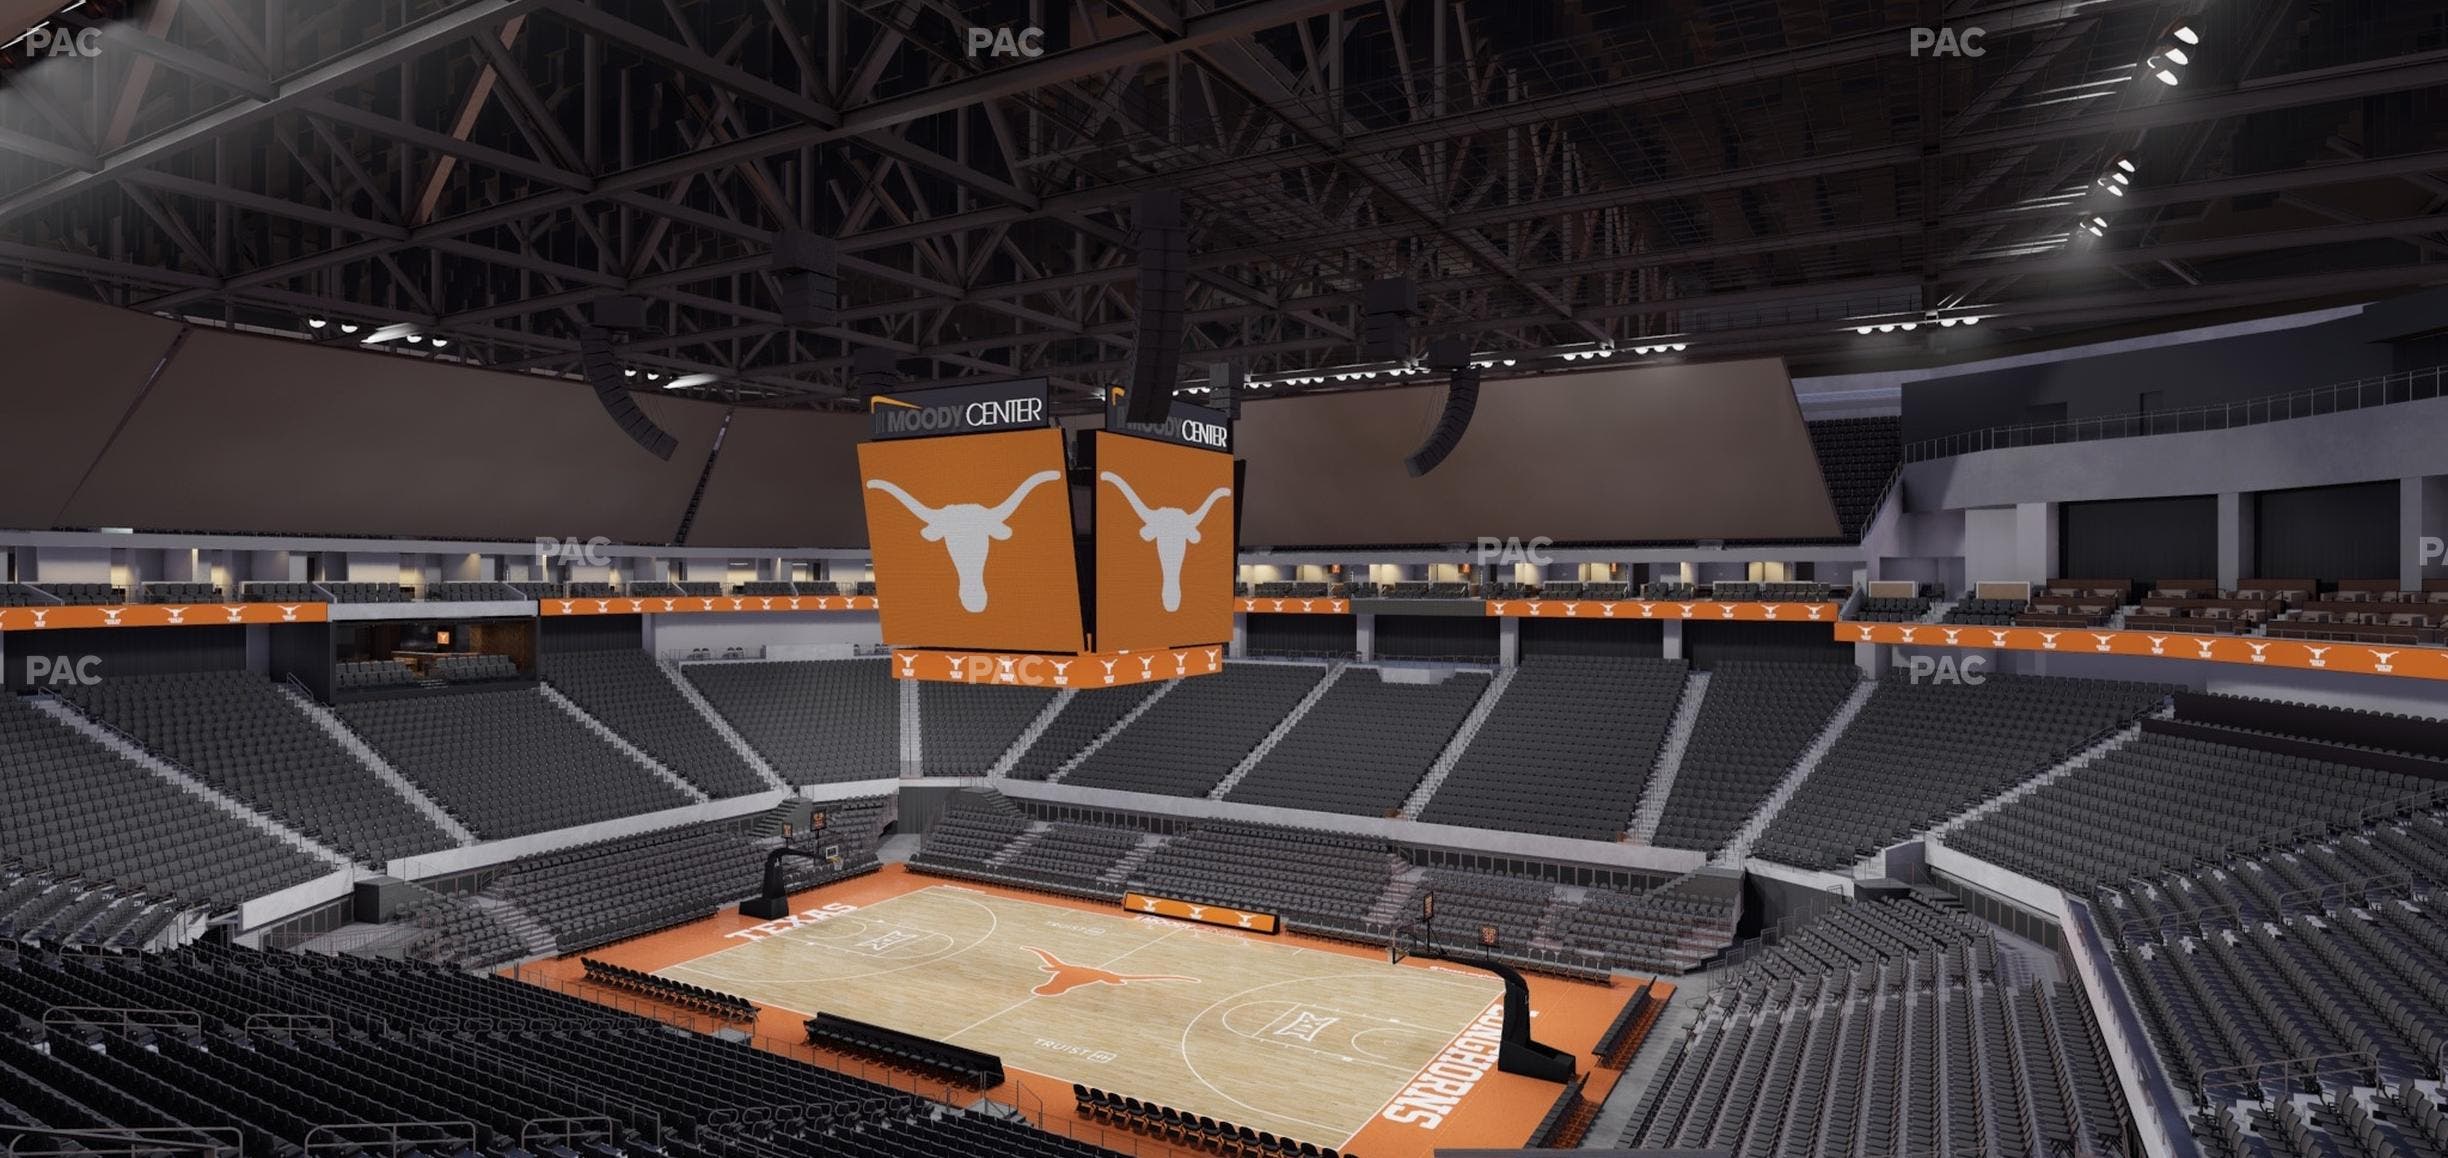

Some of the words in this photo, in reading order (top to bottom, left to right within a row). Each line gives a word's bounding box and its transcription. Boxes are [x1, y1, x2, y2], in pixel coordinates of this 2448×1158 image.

[888, 406, 964, 432] MOODY
[966, 397, 1042, 427] CENTER
[1181, 419, 1228, 448] CENTER
[723, 902, 859, 943] TEXAS
[1034, 1038, 1089, 1056] TRUIST
